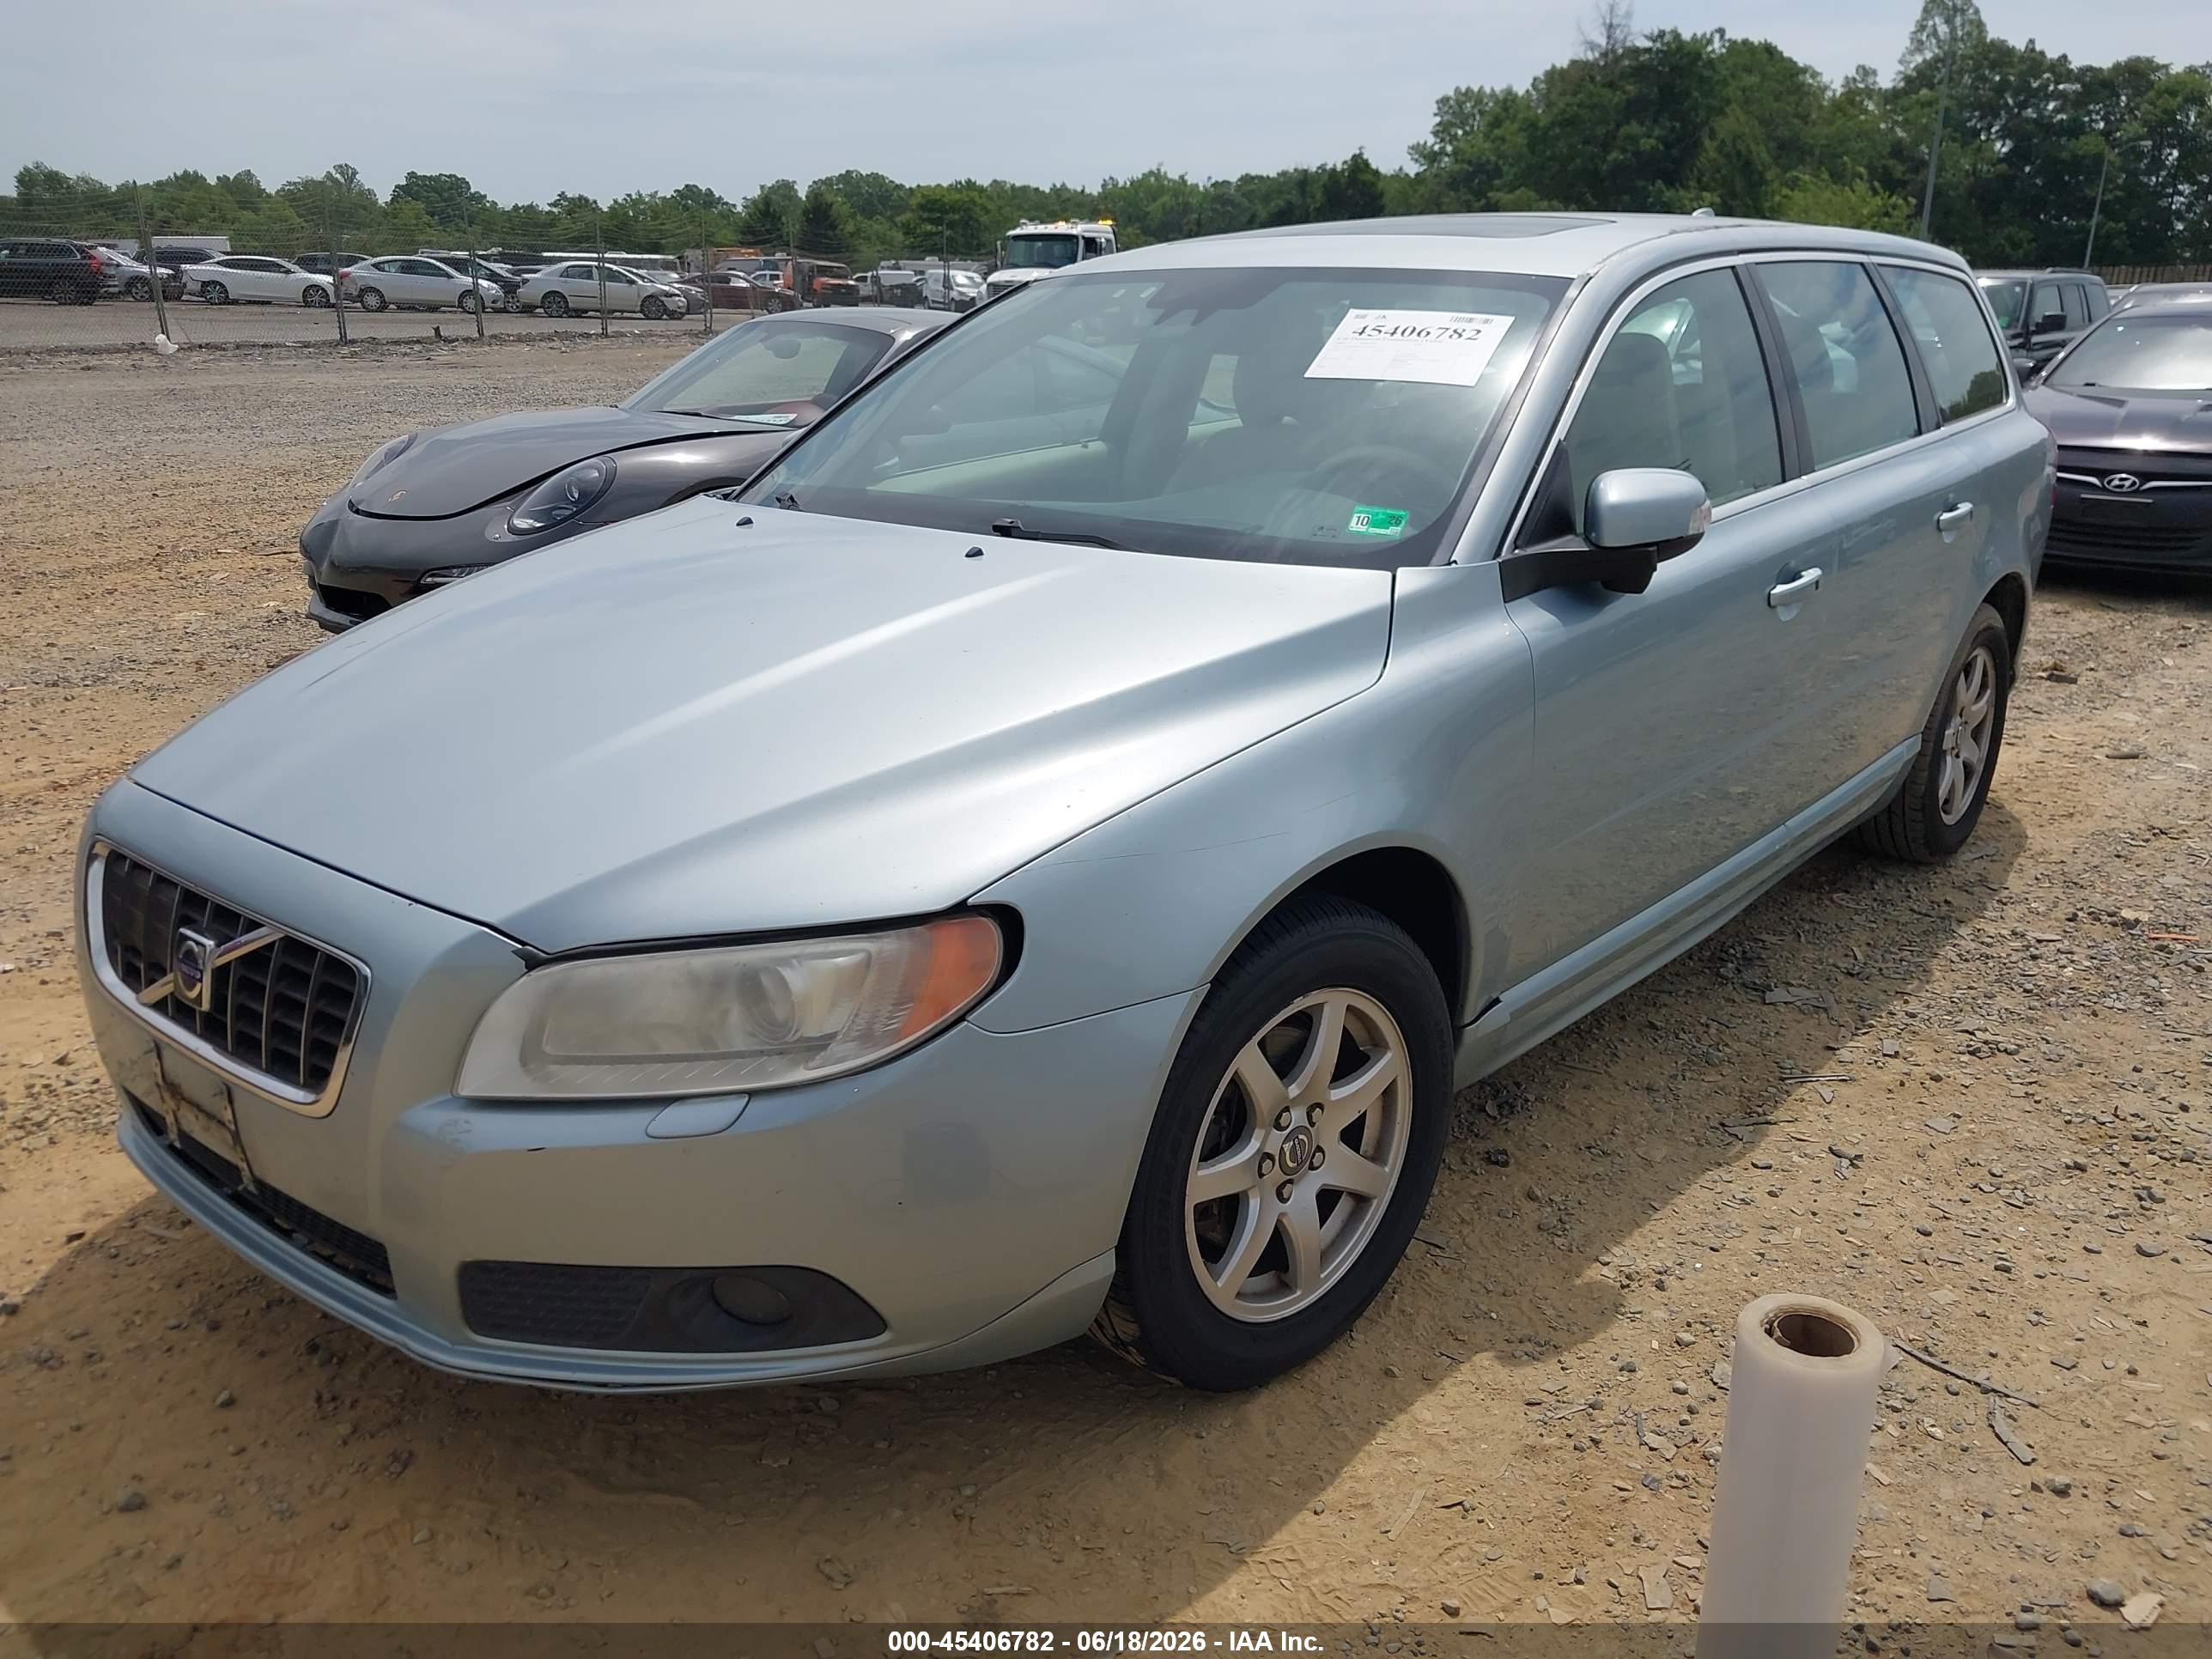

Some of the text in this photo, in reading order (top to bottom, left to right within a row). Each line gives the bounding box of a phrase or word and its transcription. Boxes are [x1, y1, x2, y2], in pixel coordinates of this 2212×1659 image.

[1352, 324, 1482, 341] 45406782
[1355, 515, 1370, 526] 10
[1388, 515, 1403, 526] 26
